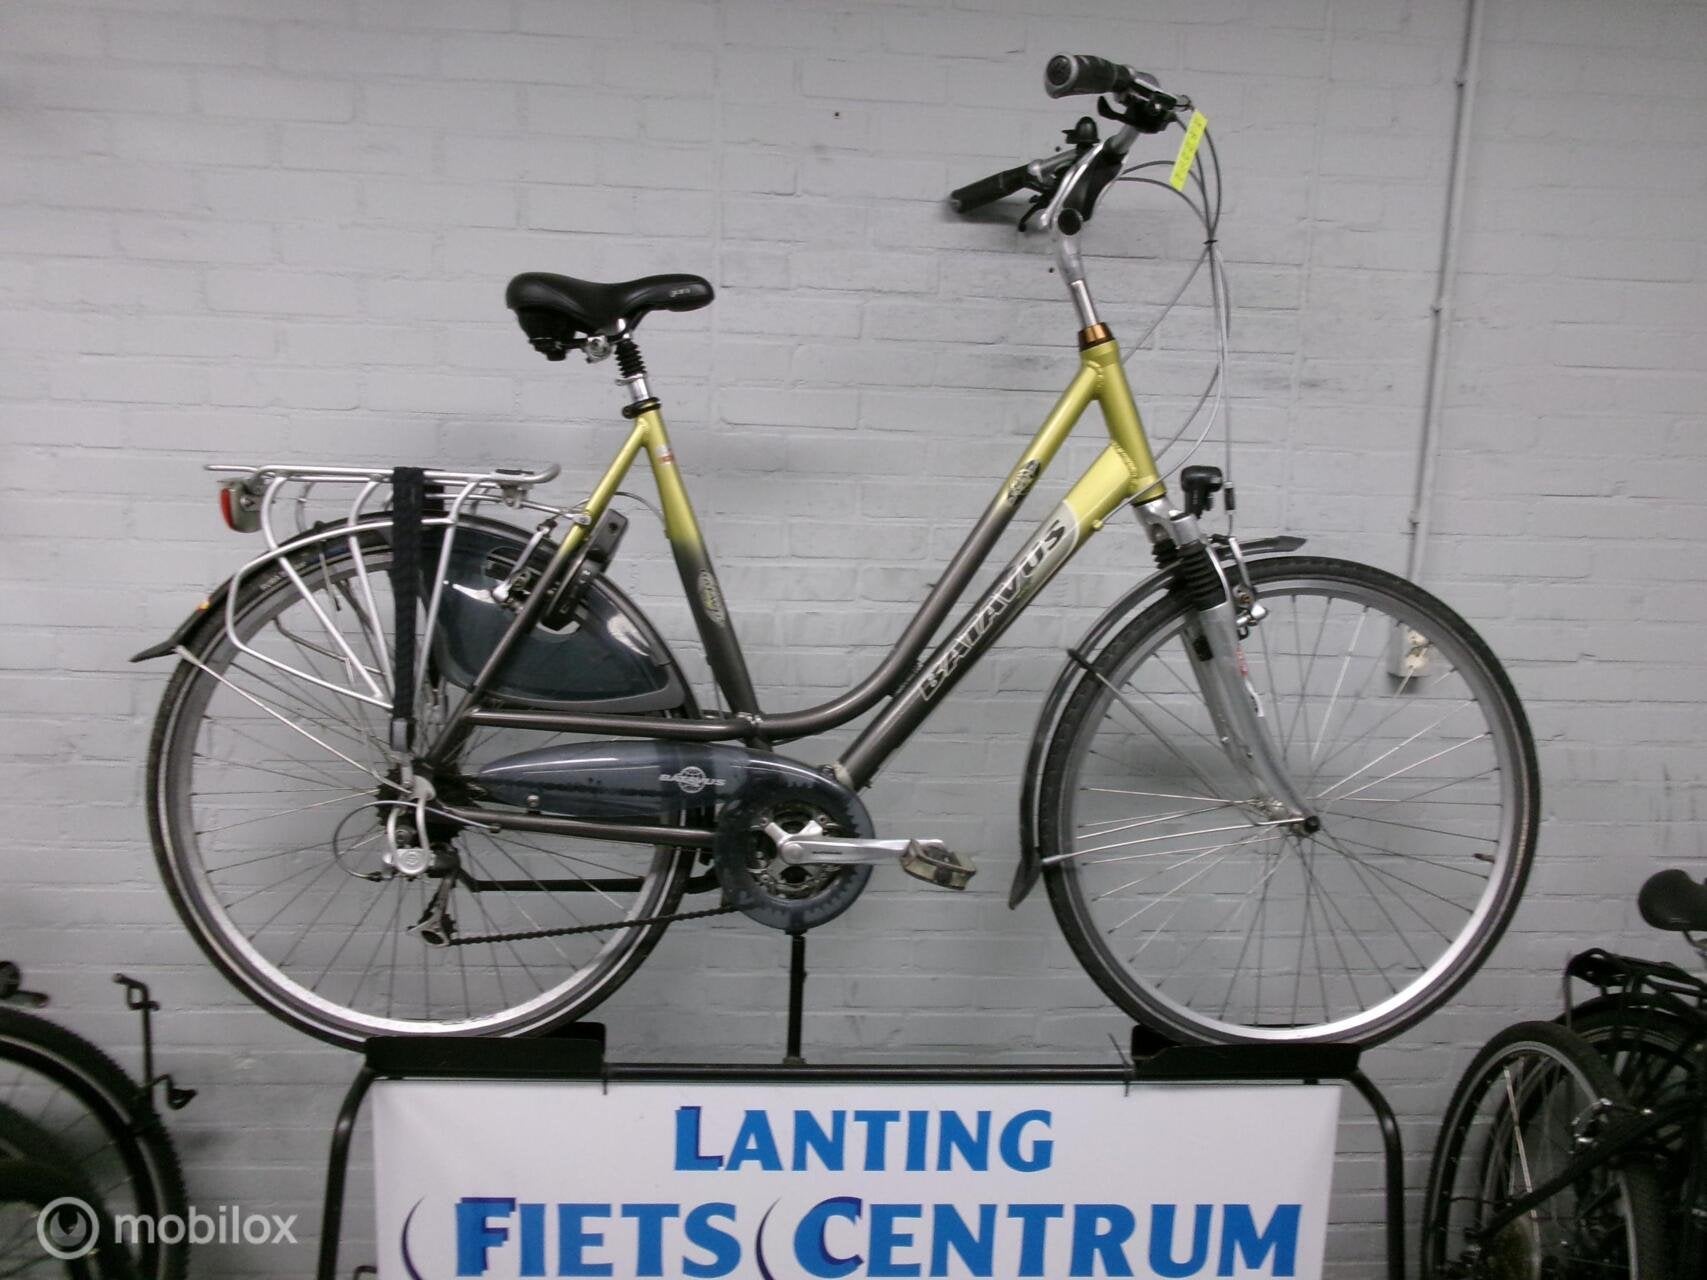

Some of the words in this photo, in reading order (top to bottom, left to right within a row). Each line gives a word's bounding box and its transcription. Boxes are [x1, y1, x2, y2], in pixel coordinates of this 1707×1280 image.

[920, 519, 1067, 702] BATAVUS
[675, 1106, 1054, 1172] LANTING
[456, 1197, 743, 1278] FIETS
[792, 1196, 1302, 1278] CENTRUM
